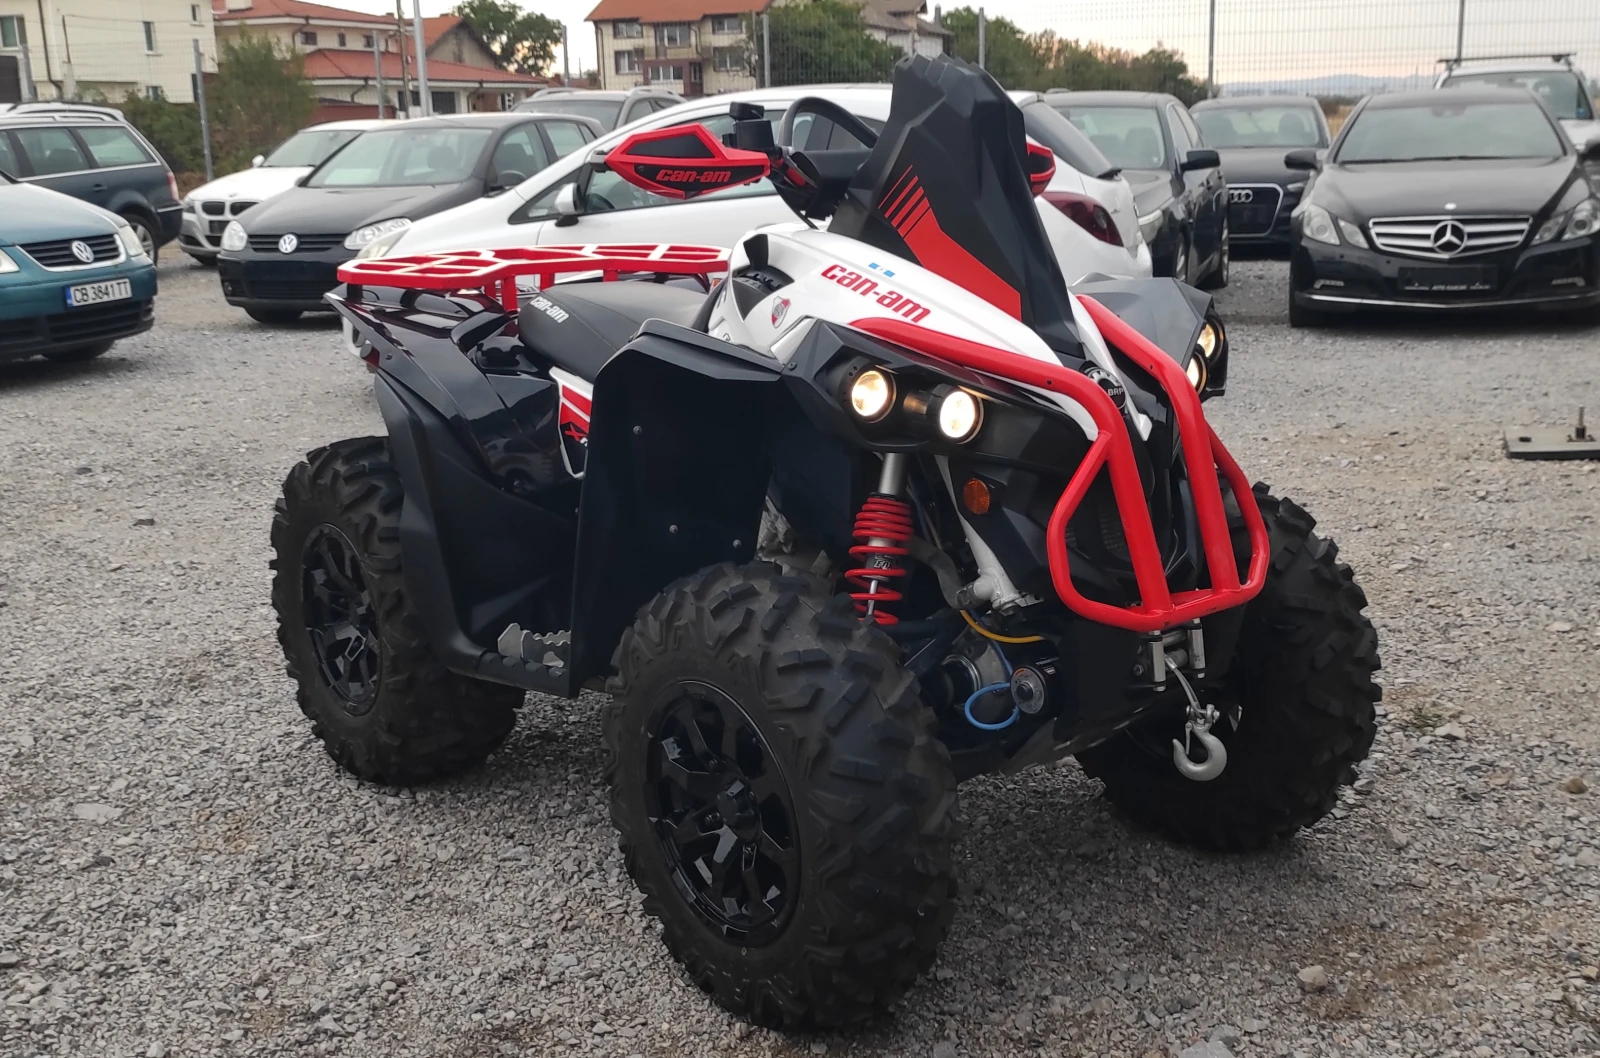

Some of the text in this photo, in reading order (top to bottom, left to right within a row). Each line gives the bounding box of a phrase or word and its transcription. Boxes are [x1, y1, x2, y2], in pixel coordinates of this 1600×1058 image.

[656, 169, 731, 183] can-am
[821, 264, 931, 323] can-am
[529, 296, 570, 323] can-am
[1107, 387, 1124, 396] BRP
